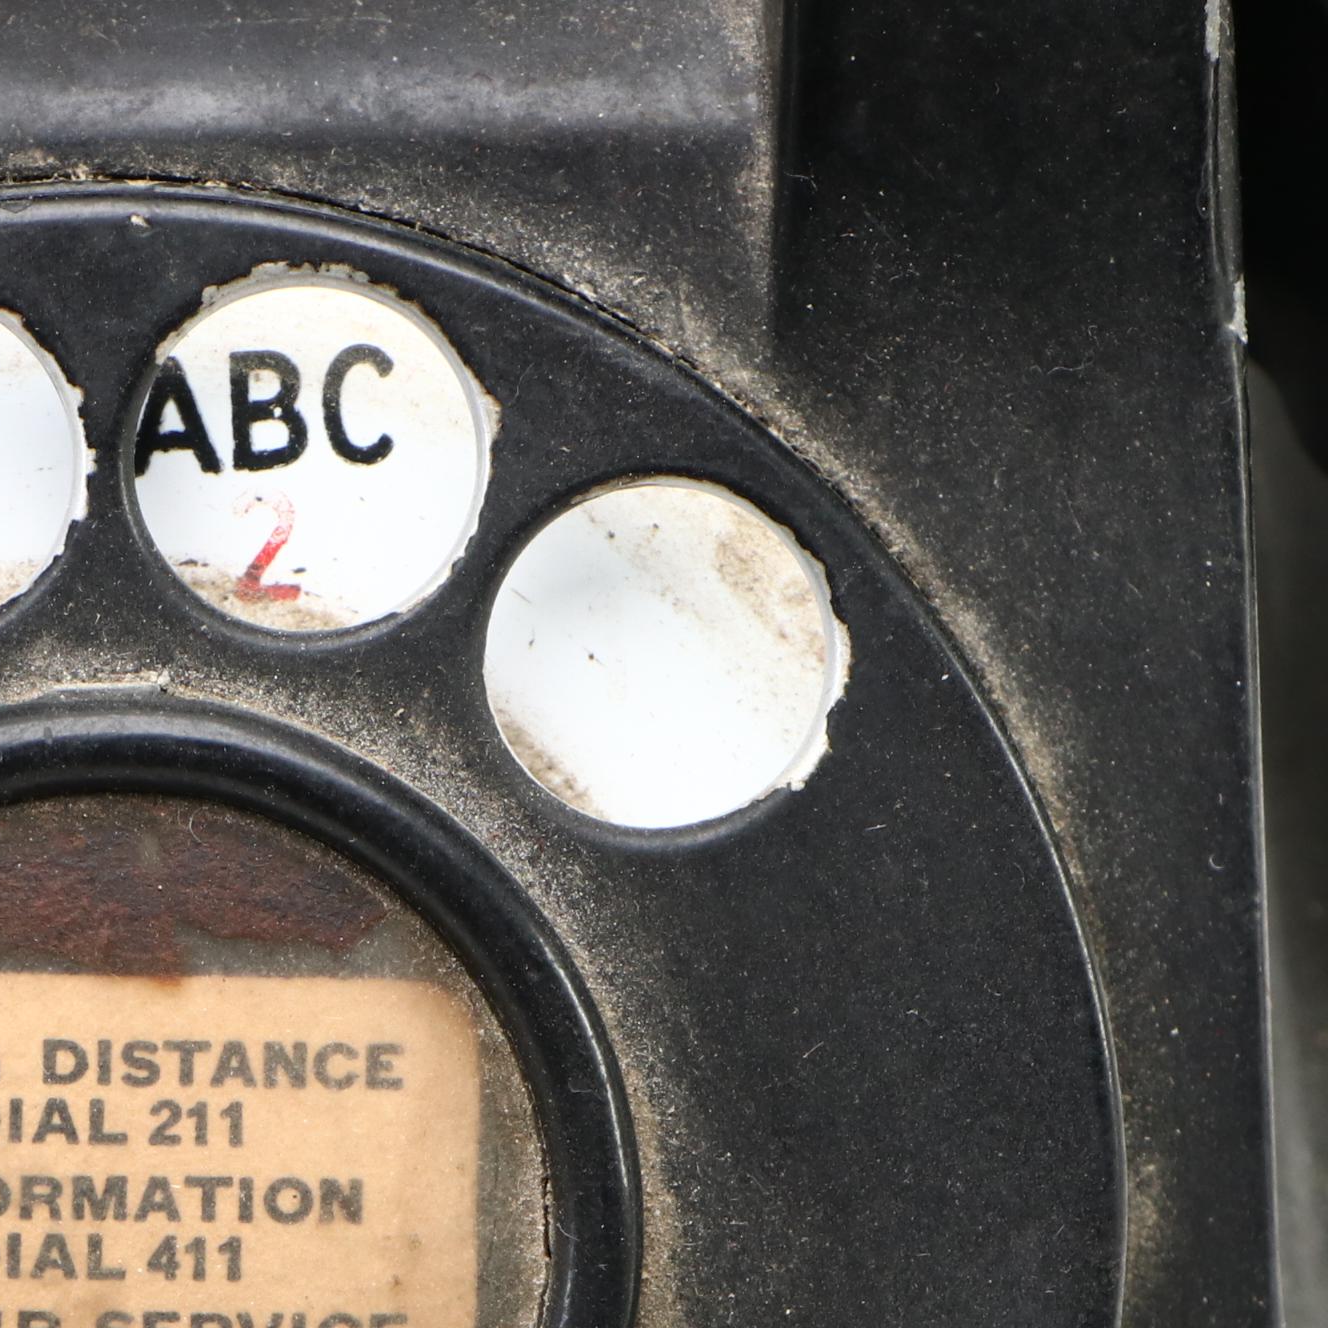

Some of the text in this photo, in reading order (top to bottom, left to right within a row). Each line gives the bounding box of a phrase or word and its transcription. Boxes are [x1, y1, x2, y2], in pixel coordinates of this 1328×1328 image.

[134, 343, 396, 479] ABC
[233, 490, 302, 602] 2
[42, 1039, 404, 1090] DISTANCE
[147, 1100, 245, 1147] 211
[147, 1236, 244, 1283] 411
